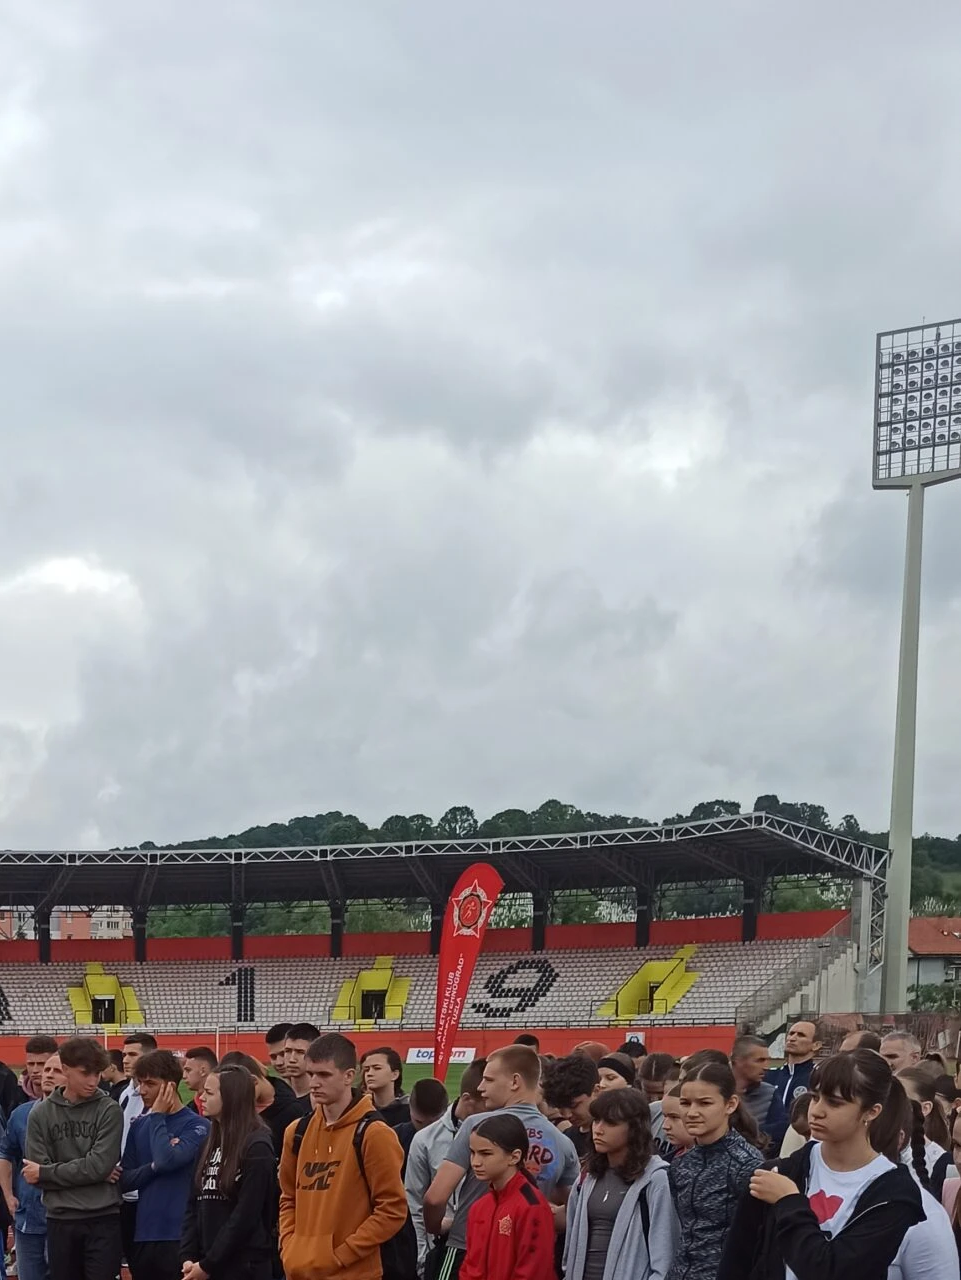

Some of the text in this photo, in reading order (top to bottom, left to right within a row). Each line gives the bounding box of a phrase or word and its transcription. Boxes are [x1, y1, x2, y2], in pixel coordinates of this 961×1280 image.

[436, 972, 455, 1042] ATLETSKI KLUB
[451, 997, 462, 1025] TUZLA
